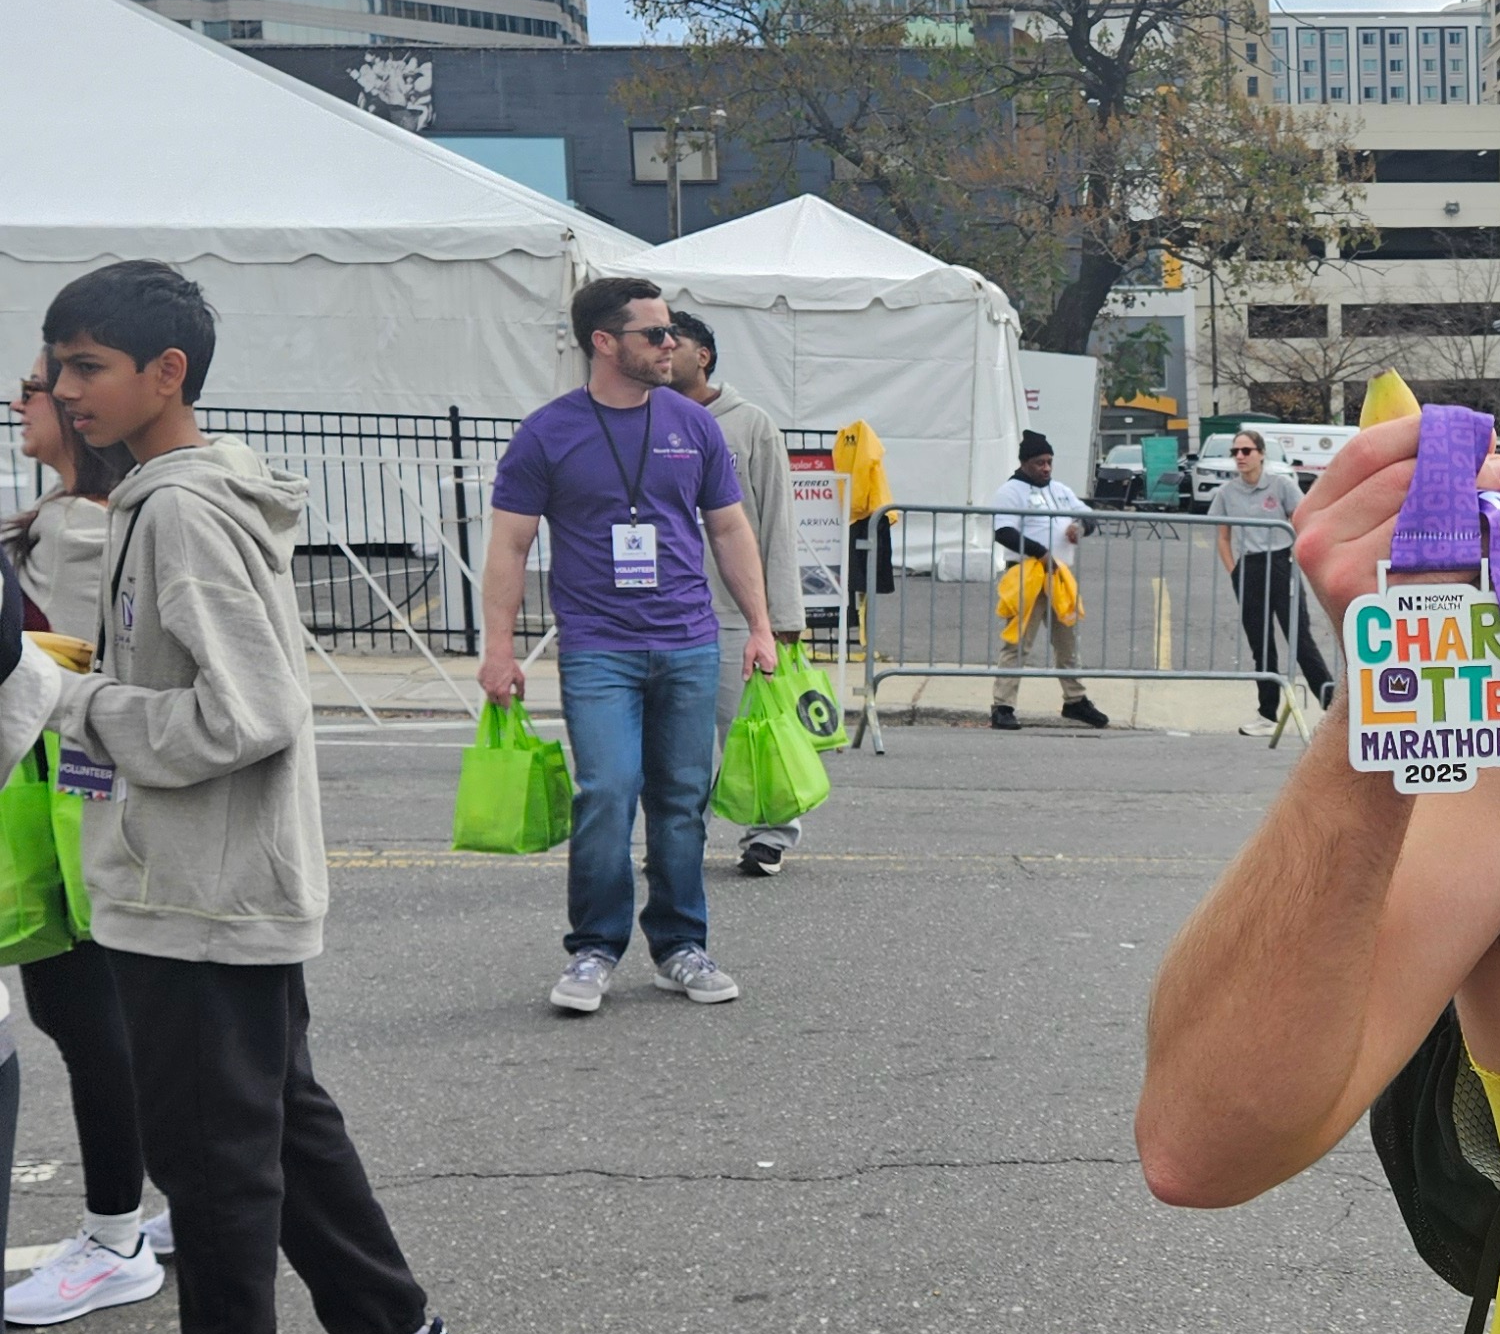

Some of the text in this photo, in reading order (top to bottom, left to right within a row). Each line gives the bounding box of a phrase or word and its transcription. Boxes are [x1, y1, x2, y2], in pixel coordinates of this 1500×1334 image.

[790, 460, 812, 470] oplar
[794, 488, 833, 500] KING
[1425, 595, 1464, 603] NOVANT
[1405, 763, 1467, 784] 2025
